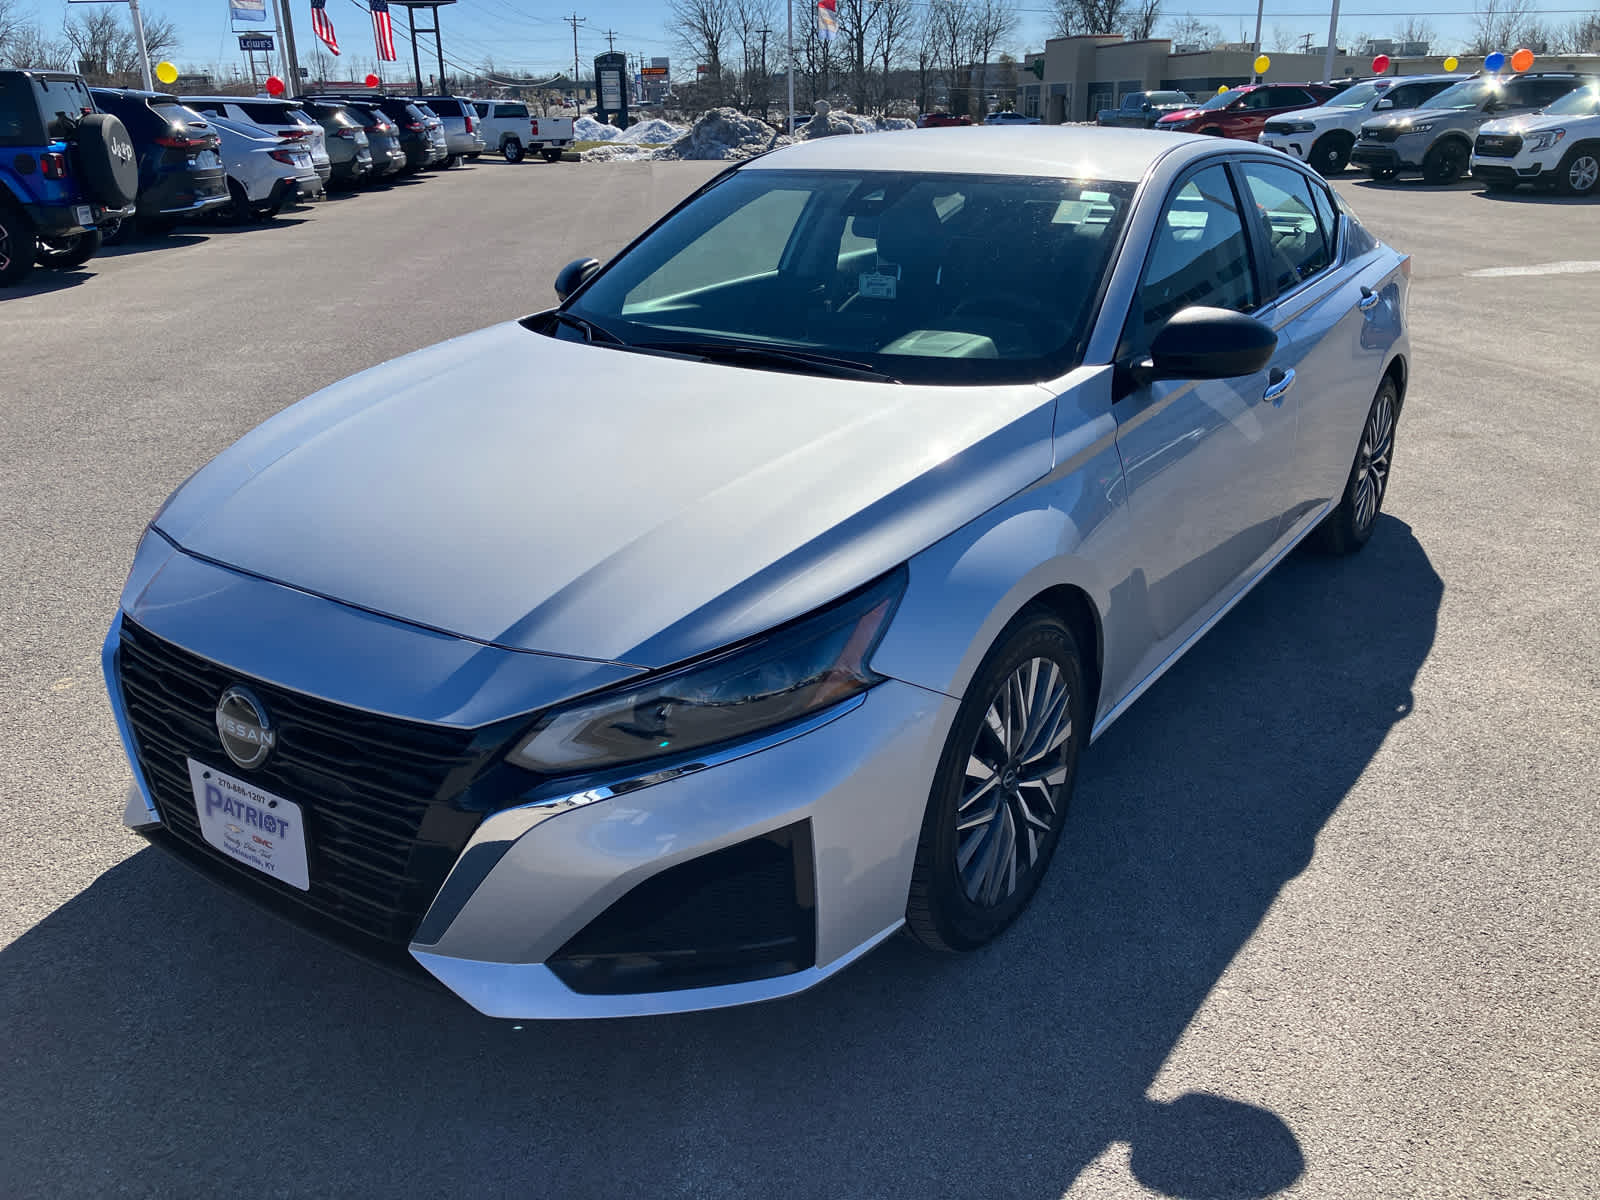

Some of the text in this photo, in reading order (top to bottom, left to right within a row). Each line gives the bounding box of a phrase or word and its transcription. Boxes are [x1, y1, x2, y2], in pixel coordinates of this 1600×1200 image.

[241, 39, 273, 48] LOWE'S
[111, 136, 133, 161] Jeep
[216, 713, 273, 745] NISSAN
[205, 782, 289, 841] PATRIOT
